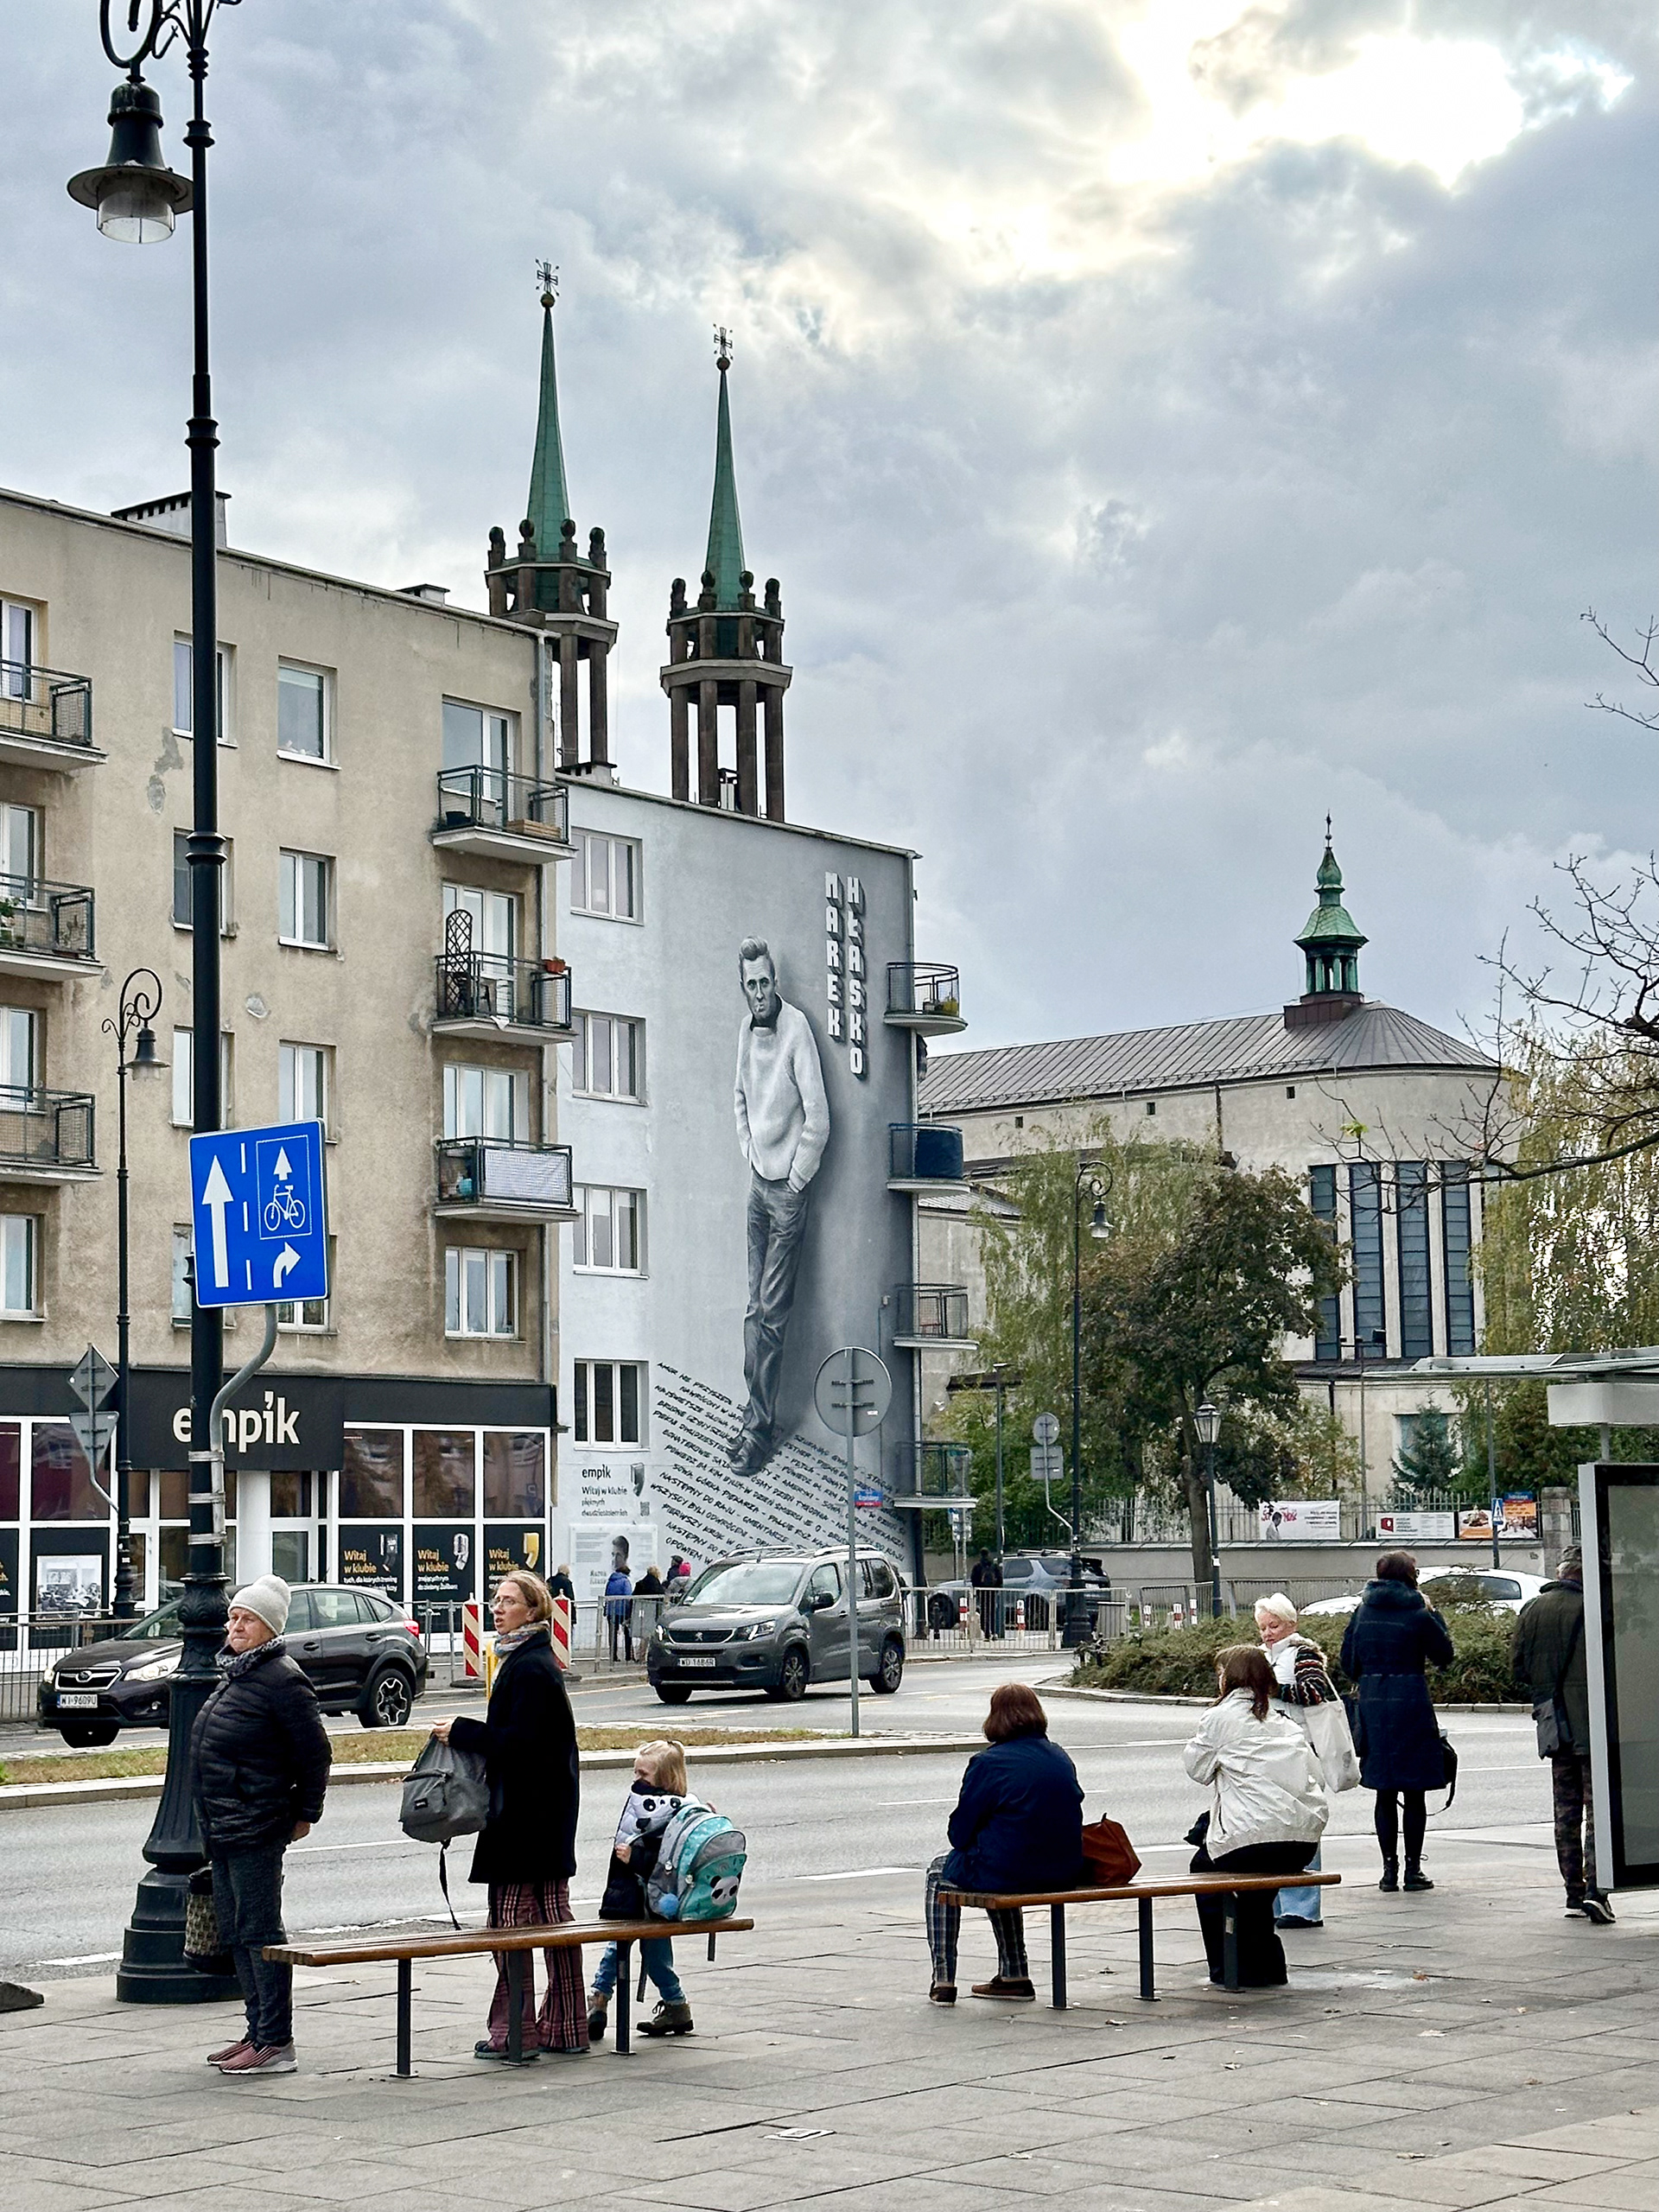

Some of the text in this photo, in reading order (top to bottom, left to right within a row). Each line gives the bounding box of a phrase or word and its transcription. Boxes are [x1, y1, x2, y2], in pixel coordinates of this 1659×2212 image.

[825, 871, 842, 1039] MAREK
[847, 876, 865, 1077] HŁASKO
[582, 1464, 612, 1480] empik
[650, 1484, 689, 1508] WSZYSCY
[344, 1549, 366, 1561] Witaj
[417, 1548, 440, 1560] Witaj
[488, 1548, 510, 1560] Witaj
[353, 1562, 377, 1573] klubie
[427, 1561, 449, 1572] klubie
